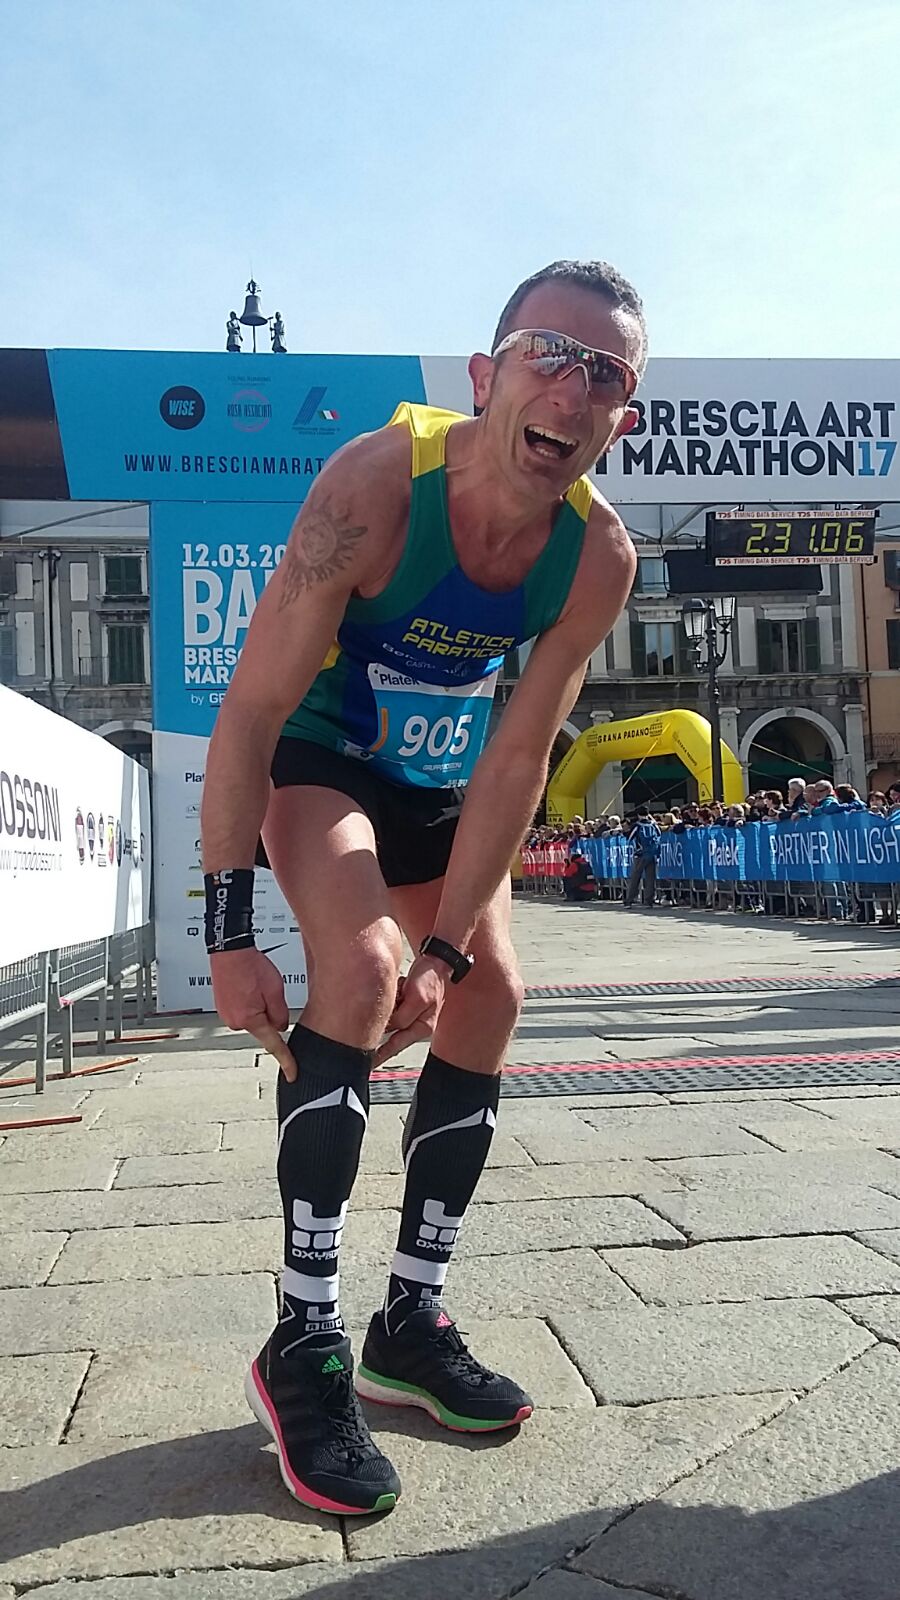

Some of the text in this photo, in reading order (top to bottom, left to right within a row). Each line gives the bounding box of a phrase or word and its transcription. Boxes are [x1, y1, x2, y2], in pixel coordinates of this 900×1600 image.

[169, 400, 196, 416] WISE
[625, 400, 895, 438] BRESCIA ART
[182, 569, 276, 646] BA
[402, 632, 505, 658] PARATICO
[410, 617, 515, 649] ATLETICA
[191, 693, 204, 706] by
[397, 714, 473, 757] 905
[598, 733, 621, 744] GRANA
[624, 727, 649, 739] PADANO
[0, 770, 61, 842] OSSONI
[708, 837, 739, 867] Platek
[770, 832, 830, 865] PARTNER
[833, 830, 850, 864] IN
